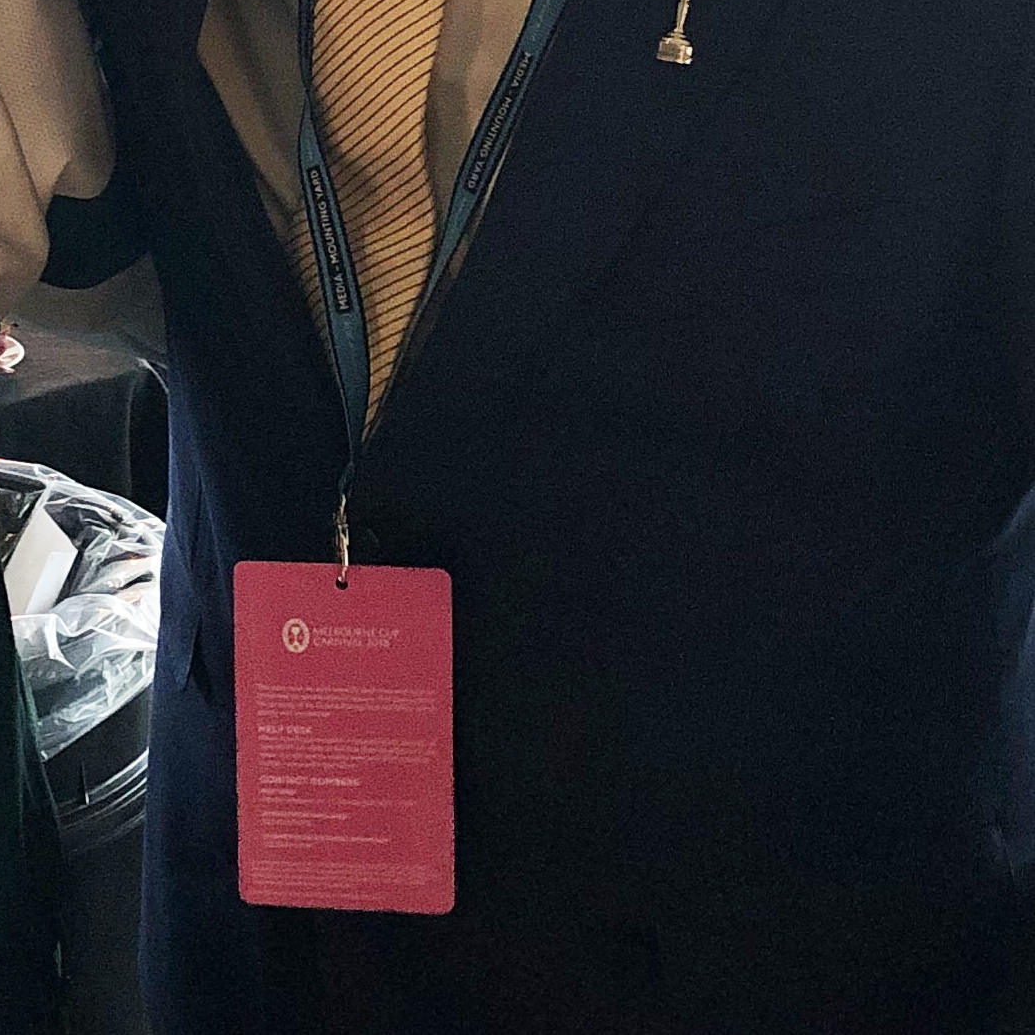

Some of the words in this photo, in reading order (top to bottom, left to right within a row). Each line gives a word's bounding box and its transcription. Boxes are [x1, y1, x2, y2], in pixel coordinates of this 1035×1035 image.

[512, 51, 531, 87] MEDIA
[479, 96, 513, 158] MOUNTING
[311, 170, 323, 200] YARD
[468, 159, 484, 189] YARD
[319, 201, 339, 264] MOUNTING
[334, 274, 349, 310] MEDIA
